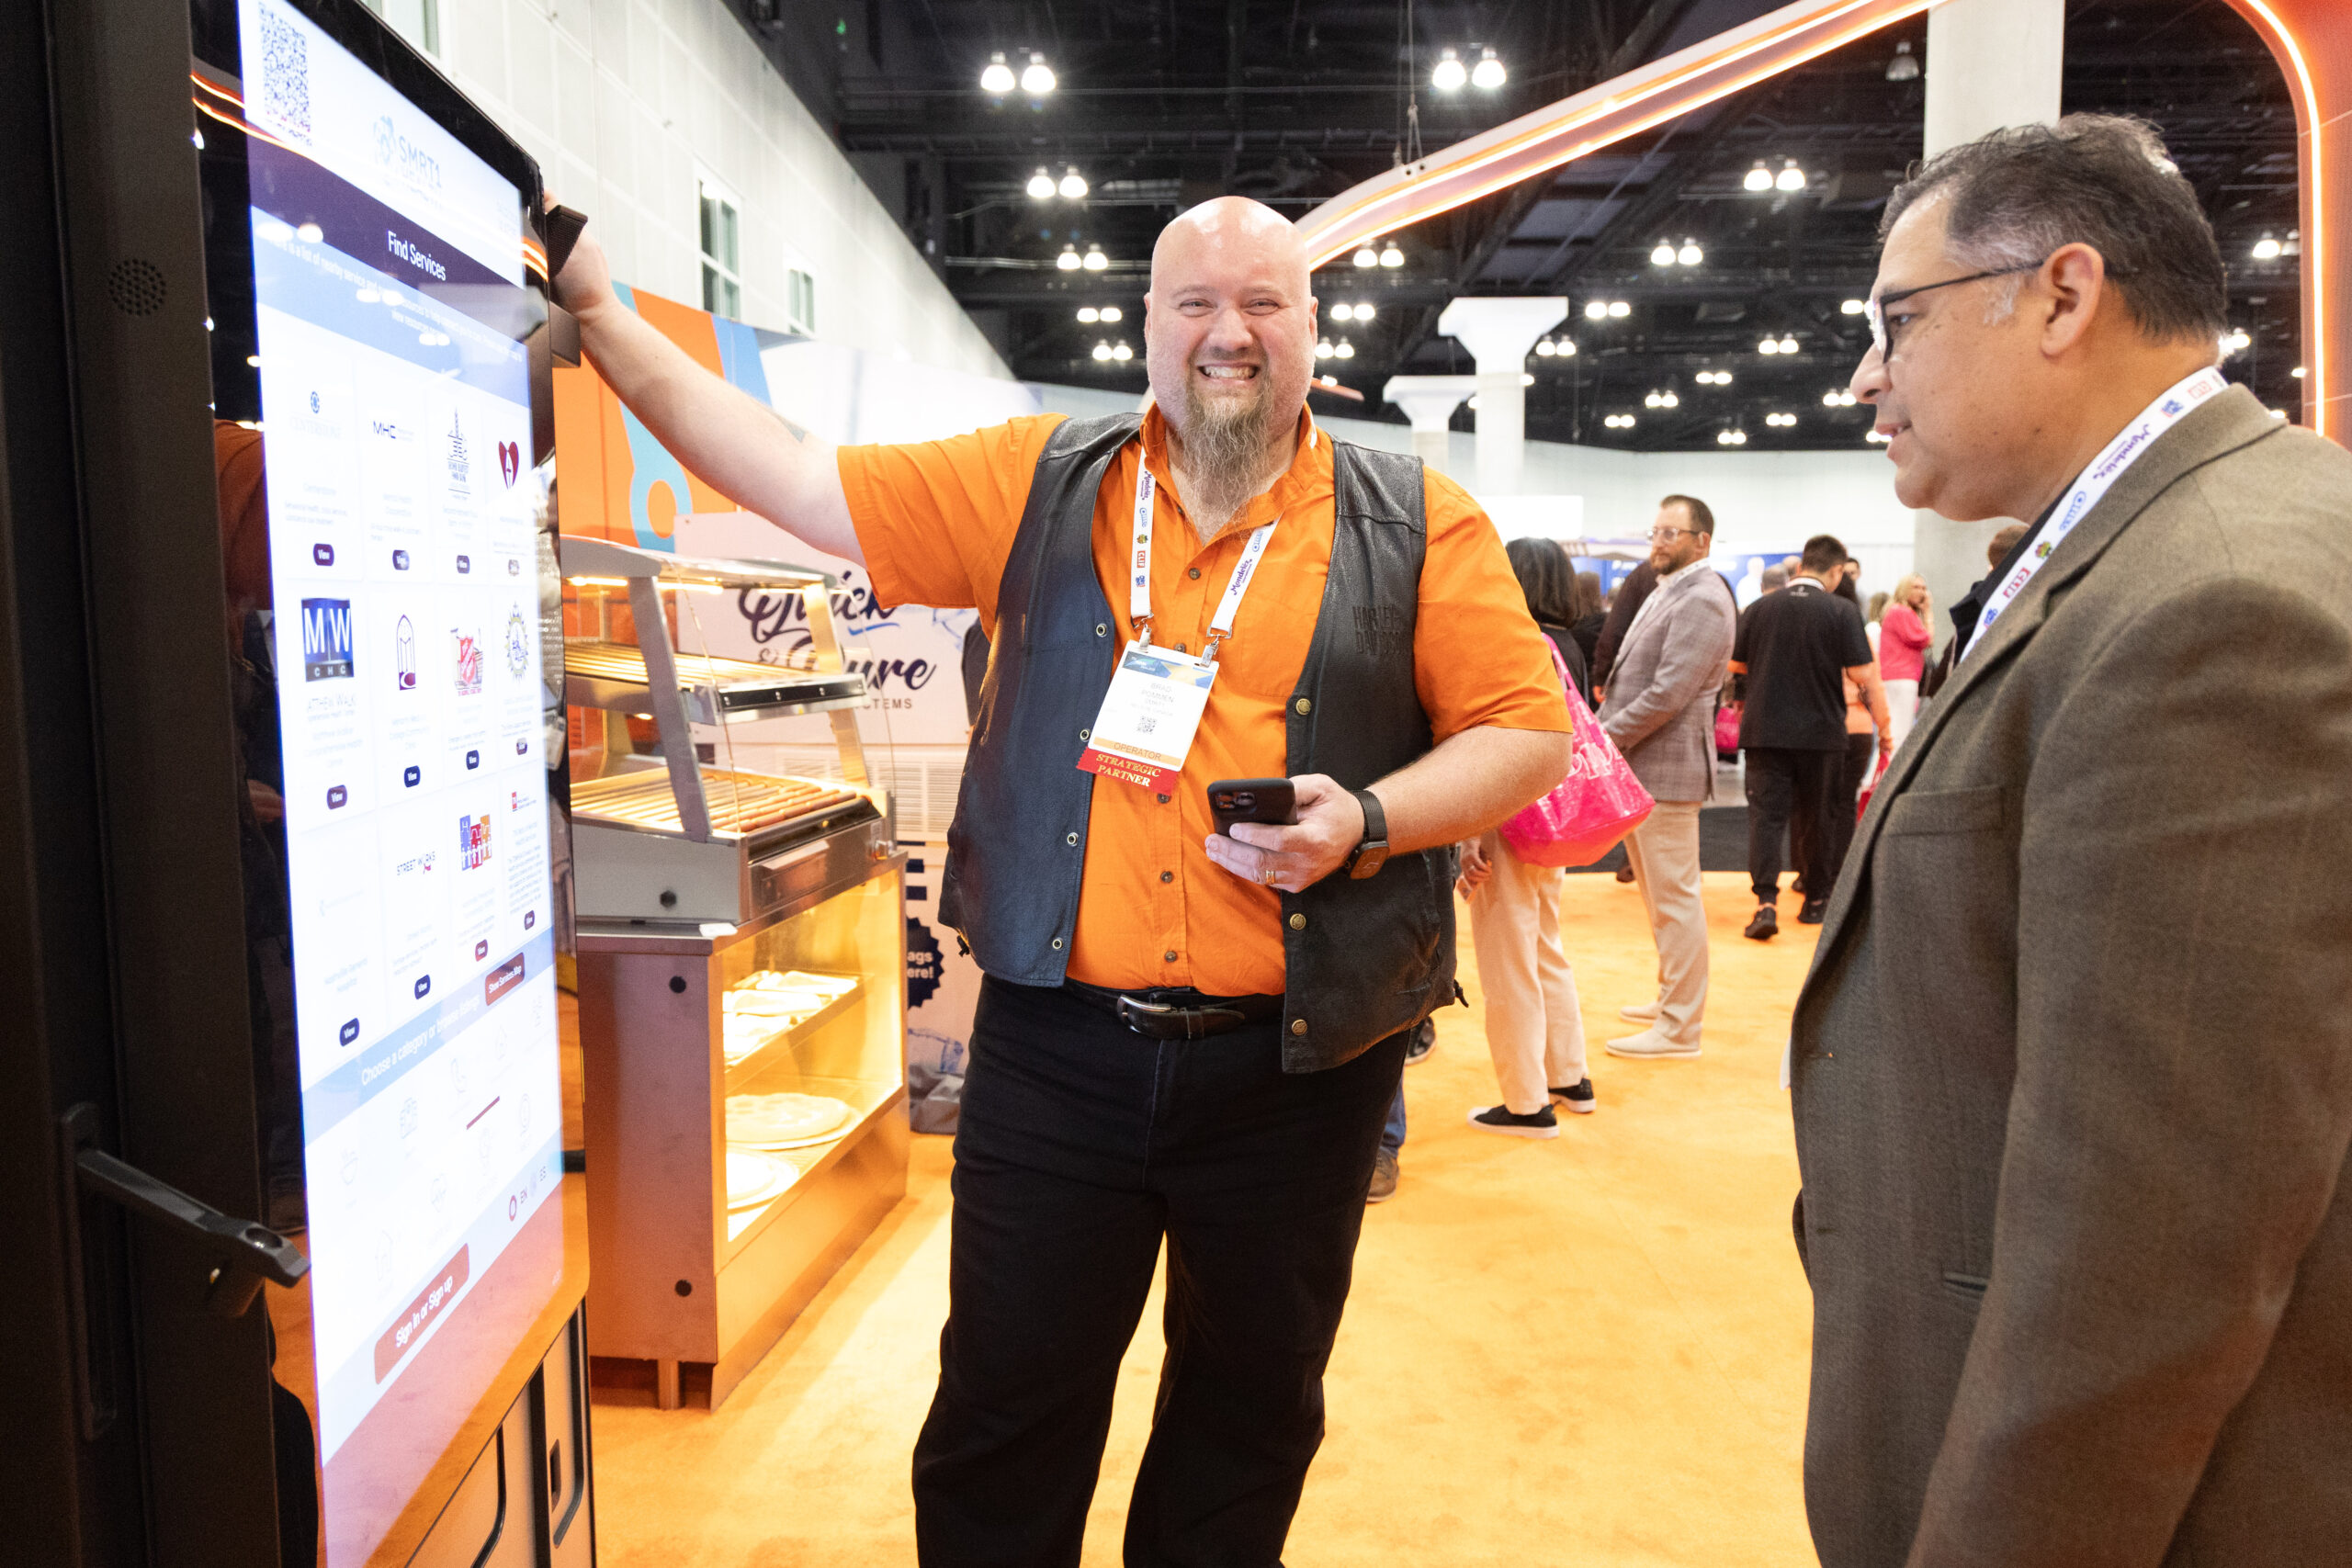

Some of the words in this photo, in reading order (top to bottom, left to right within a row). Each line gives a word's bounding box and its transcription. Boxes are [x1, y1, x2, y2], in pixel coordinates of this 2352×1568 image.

[399, 135, 442, 188] SMRT1
[387, 230, 409, 262] Find
[410, 243, 447, 281] Services
[372, 420, 397, 440] MHC
[318, 549, 330, 561] View
[304, 607, 351, 654] MW
[1114, 741, 1162, 761] OPERATOR
[1096, 753, 1161, 777] STRATEGIC
[1097, 764, 1151, 787] PARTNER
[331, 792, 344, 803] View
[908, 953, 933, 965] ags
[908, 967, 934, 979] ere!
[344, 1025, 356, 1039] View
[361, 1056, 391, 1086] Choose
[391, 1053, 398, 1063] a
[398, 1030, 428, 1062] category
[428, 1024, 435, 1039] or
[395, 1322, 413, 1348] Sign
[413, 1312, 421, 1329] in
[420, 1304, 428, 1319] or
[429, 1286, 444, 1310] Sign
[444, 1275, 453, 1292] up
